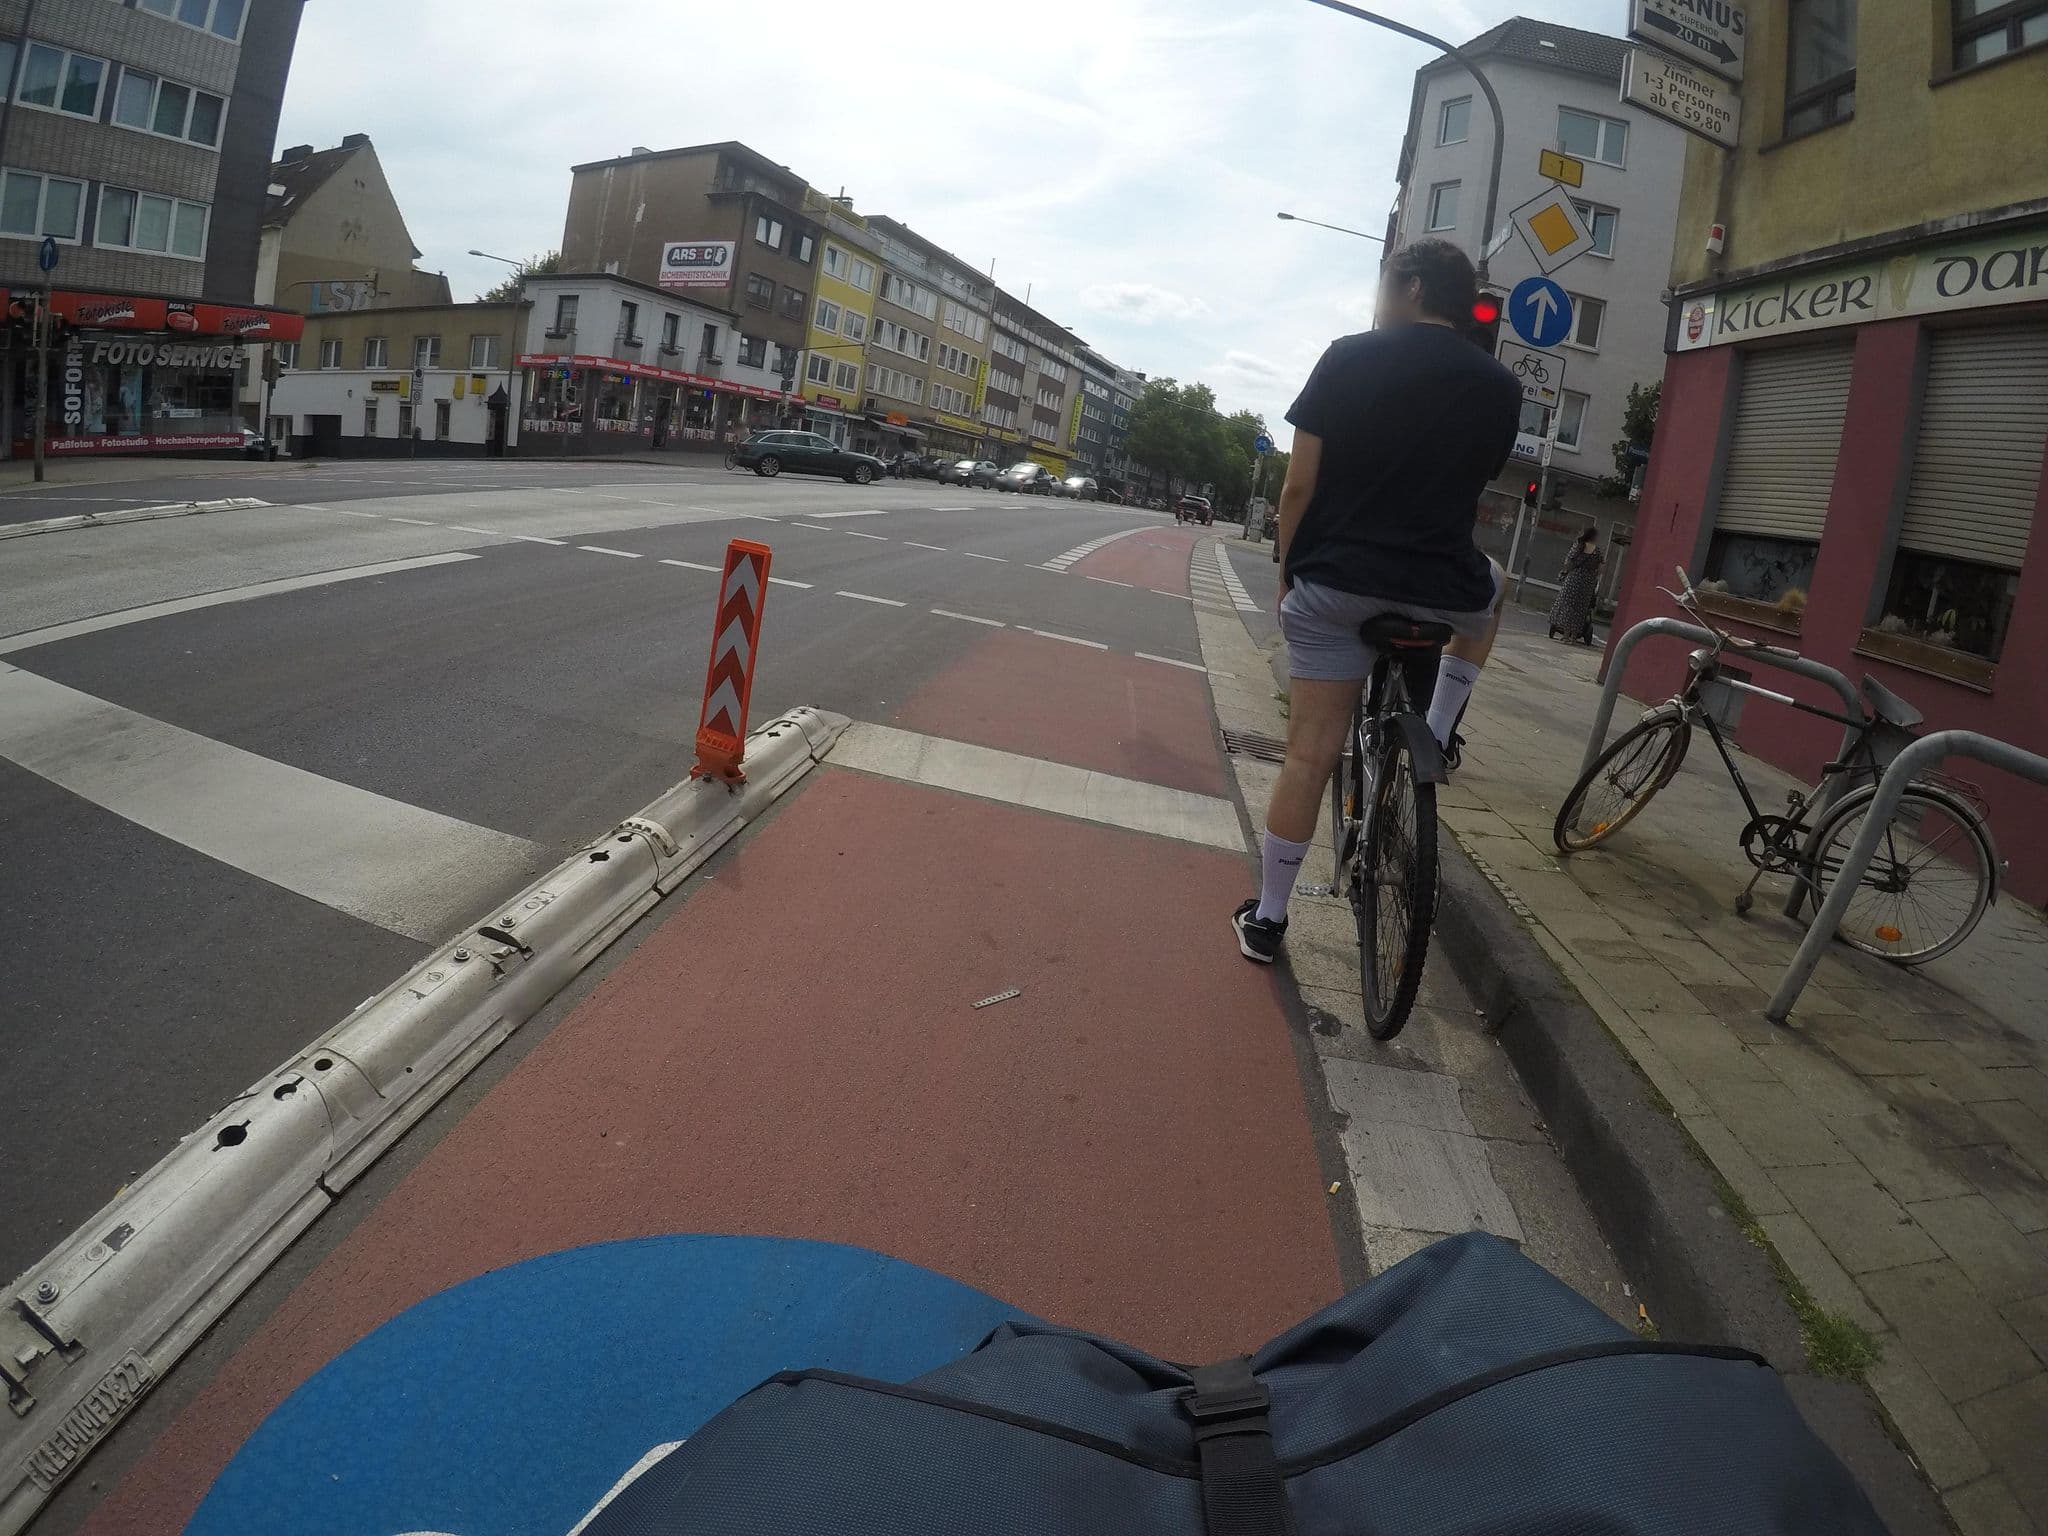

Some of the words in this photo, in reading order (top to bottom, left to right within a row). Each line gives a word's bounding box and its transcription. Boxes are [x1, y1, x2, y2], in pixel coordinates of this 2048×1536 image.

[1676, 24, 1694, 42] 20
[1697, 37, 1712, 52] m
[1679, 13, 1720, 38] SUPERIOR
[1663, 64, 1715, 99] Zimmer
[1643, 71, 1664, 90] 1-3
[1668, 83, 1731, 122] Personen
[1649, 92, 1667, 108] ab
[1684, 106, 1722, 134] 59,80
[671, 247, 713, 261] ARSEC
[1521, 385, 1538, 397] rei
[52, 440, 94, 450] Paßfotos
[101, 437, 149, 448] Fotostudio
[156, 435, 240, 446] Hochzeitsreportagen
